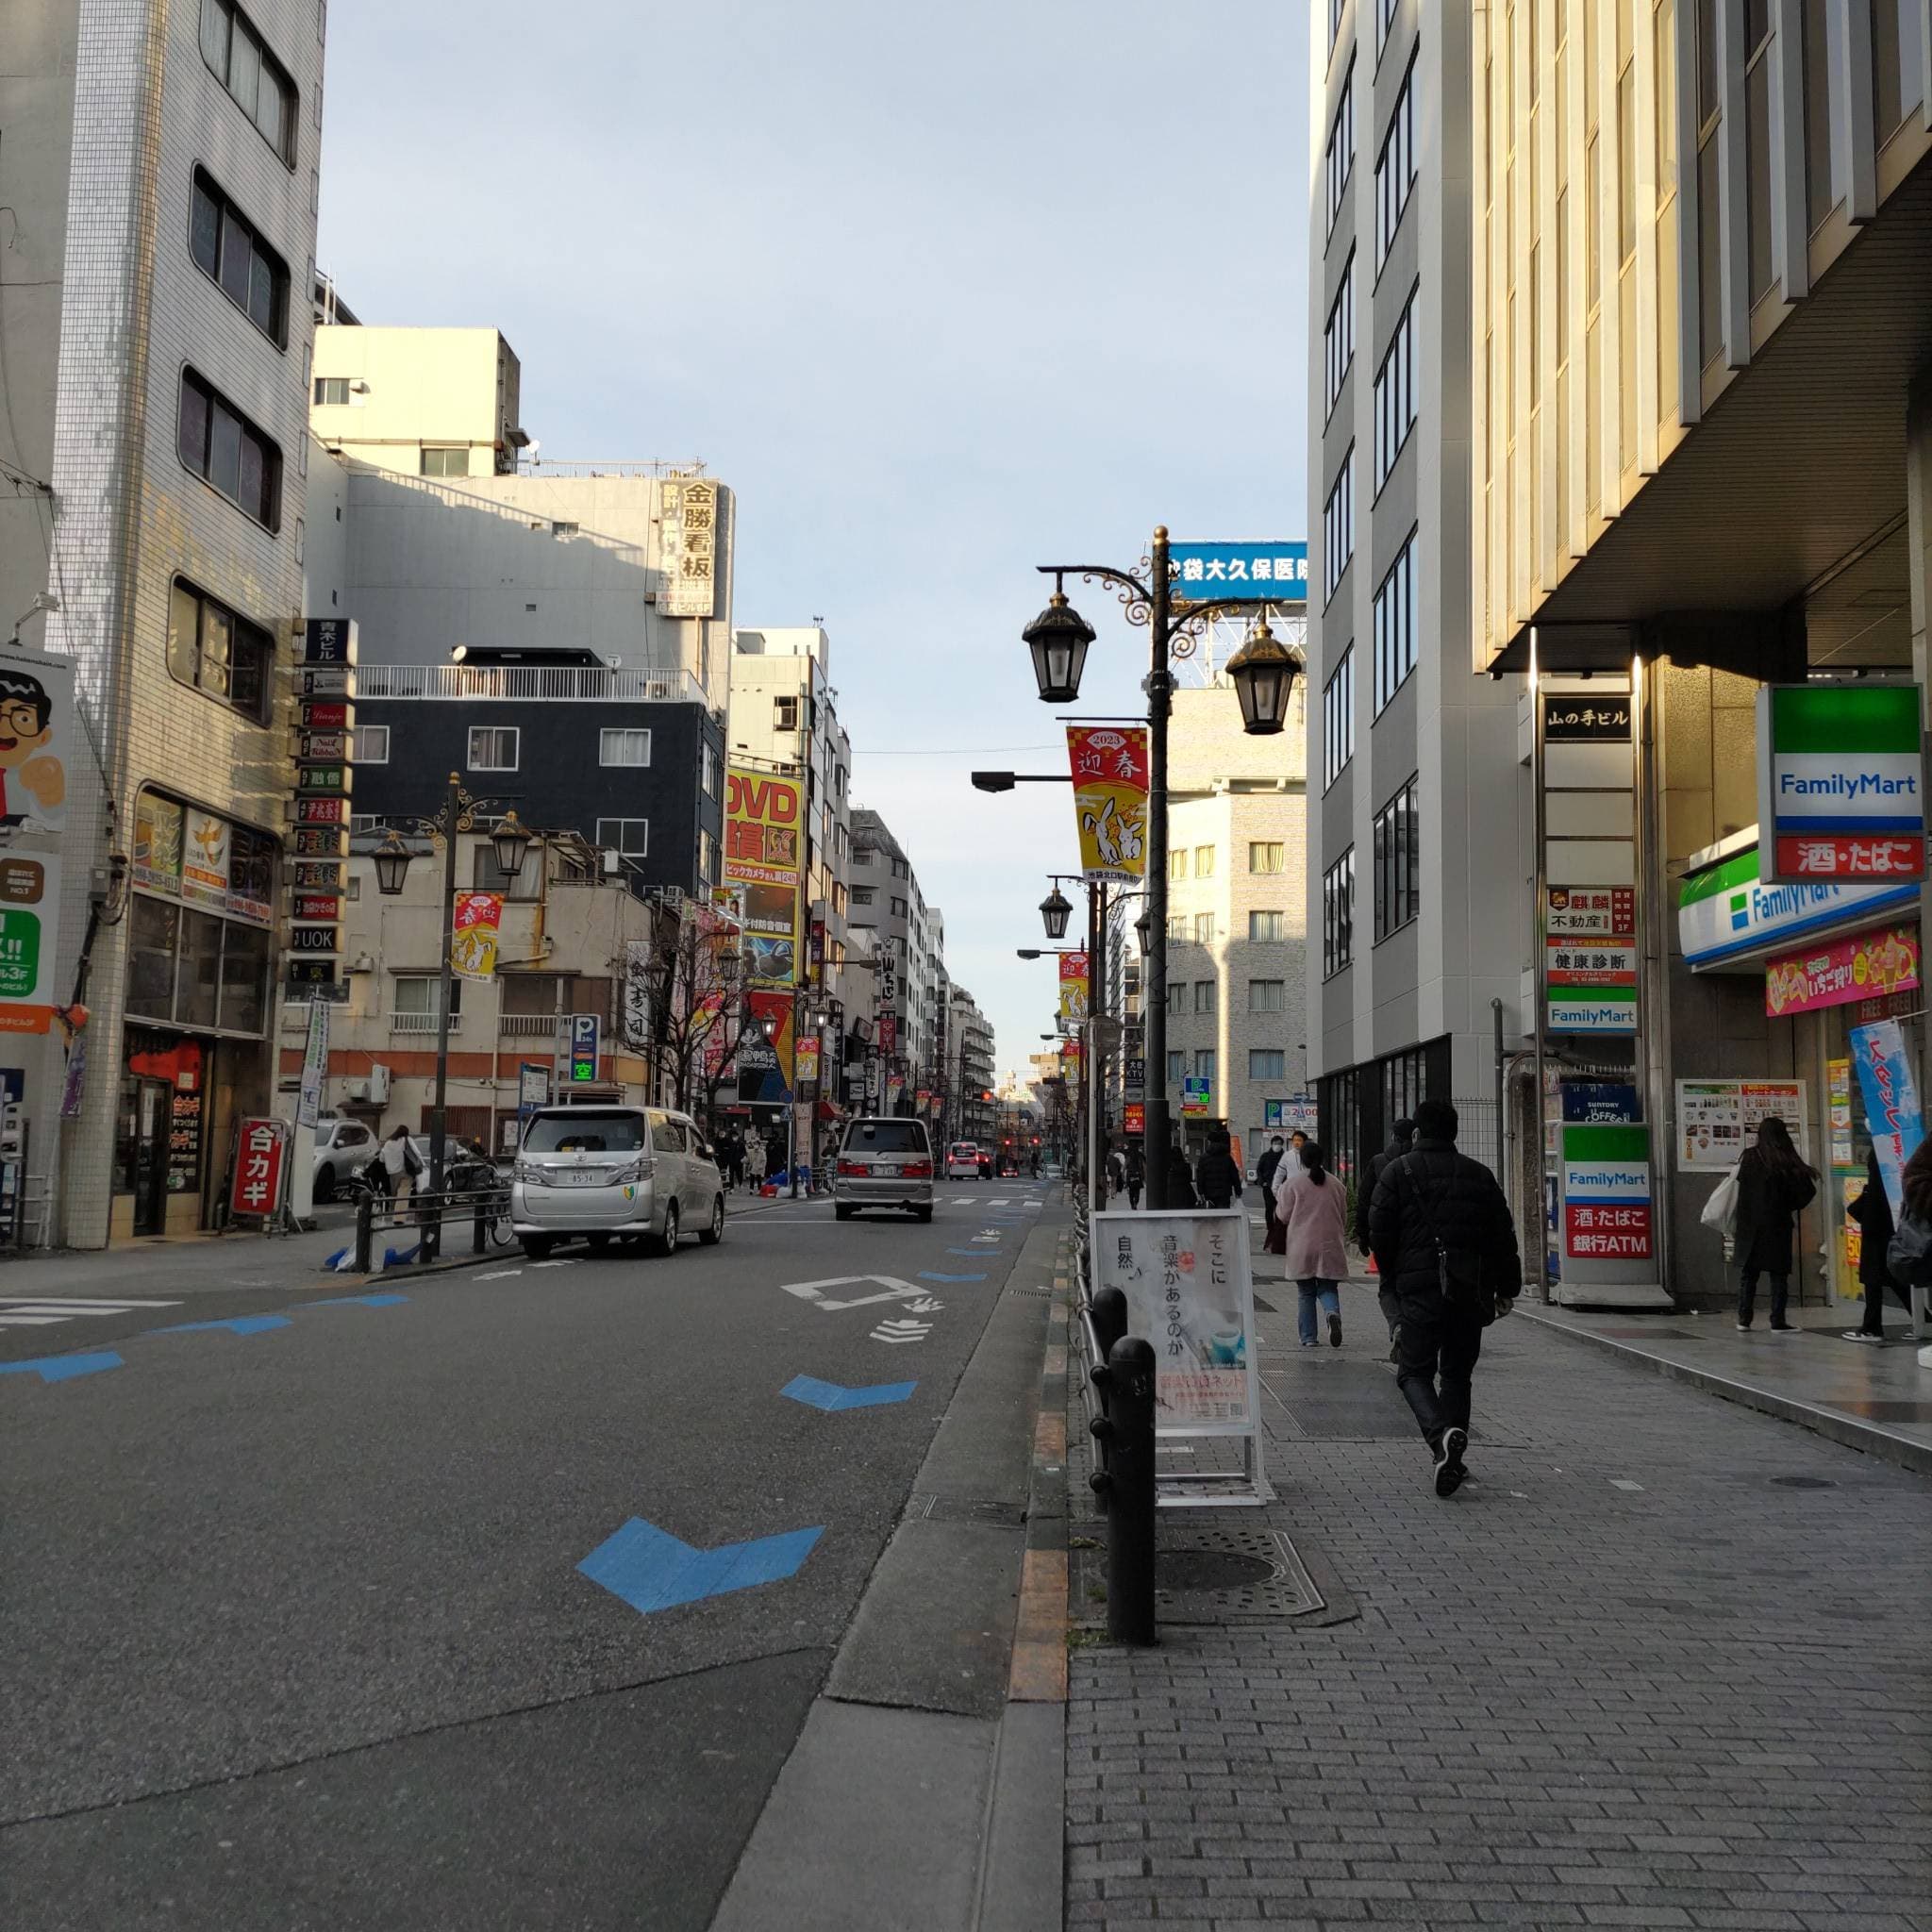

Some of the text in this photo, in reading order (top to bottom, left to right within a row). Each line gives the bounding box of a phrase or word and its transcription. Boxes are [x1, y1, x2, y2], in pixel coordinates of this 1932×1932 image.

[683, 482, 712, 579] 金勝看板
[1548, 708, 1629, 726] 山の手ビル
[1092, 735, 1121, 745] 2023
[1077, 749, 1142, 778] 迎春
[727, 774, 797, 824] DVD
[1781, 774, 1916, 799] FamilyMart
[1797, 841, 1913, 872] 酒・たばこ
[1551, 915, 1601, 928] 不動産
[302, 931, 332, 947] UOK
[1556, 954, 1626, 970] 健康診断
[1552, 1008, 1634, 1025] FamilyMart
[575, 1017, 594, 1042] P
[242, 1125, 275, 1207] 合カギ
[1570, 1172, 1645, 1188] FamilyMart
[1574, 1208, 1645, 1227] 酒・たばこ
[1117, 1235, 1133, 1270] 自然
[1573, 1236, 1647, 1253] 銀行ATM
[1208, 1234, 1226, 1285] そこに
[1162, 1235, 1183, 1356] 音楽があるのか
